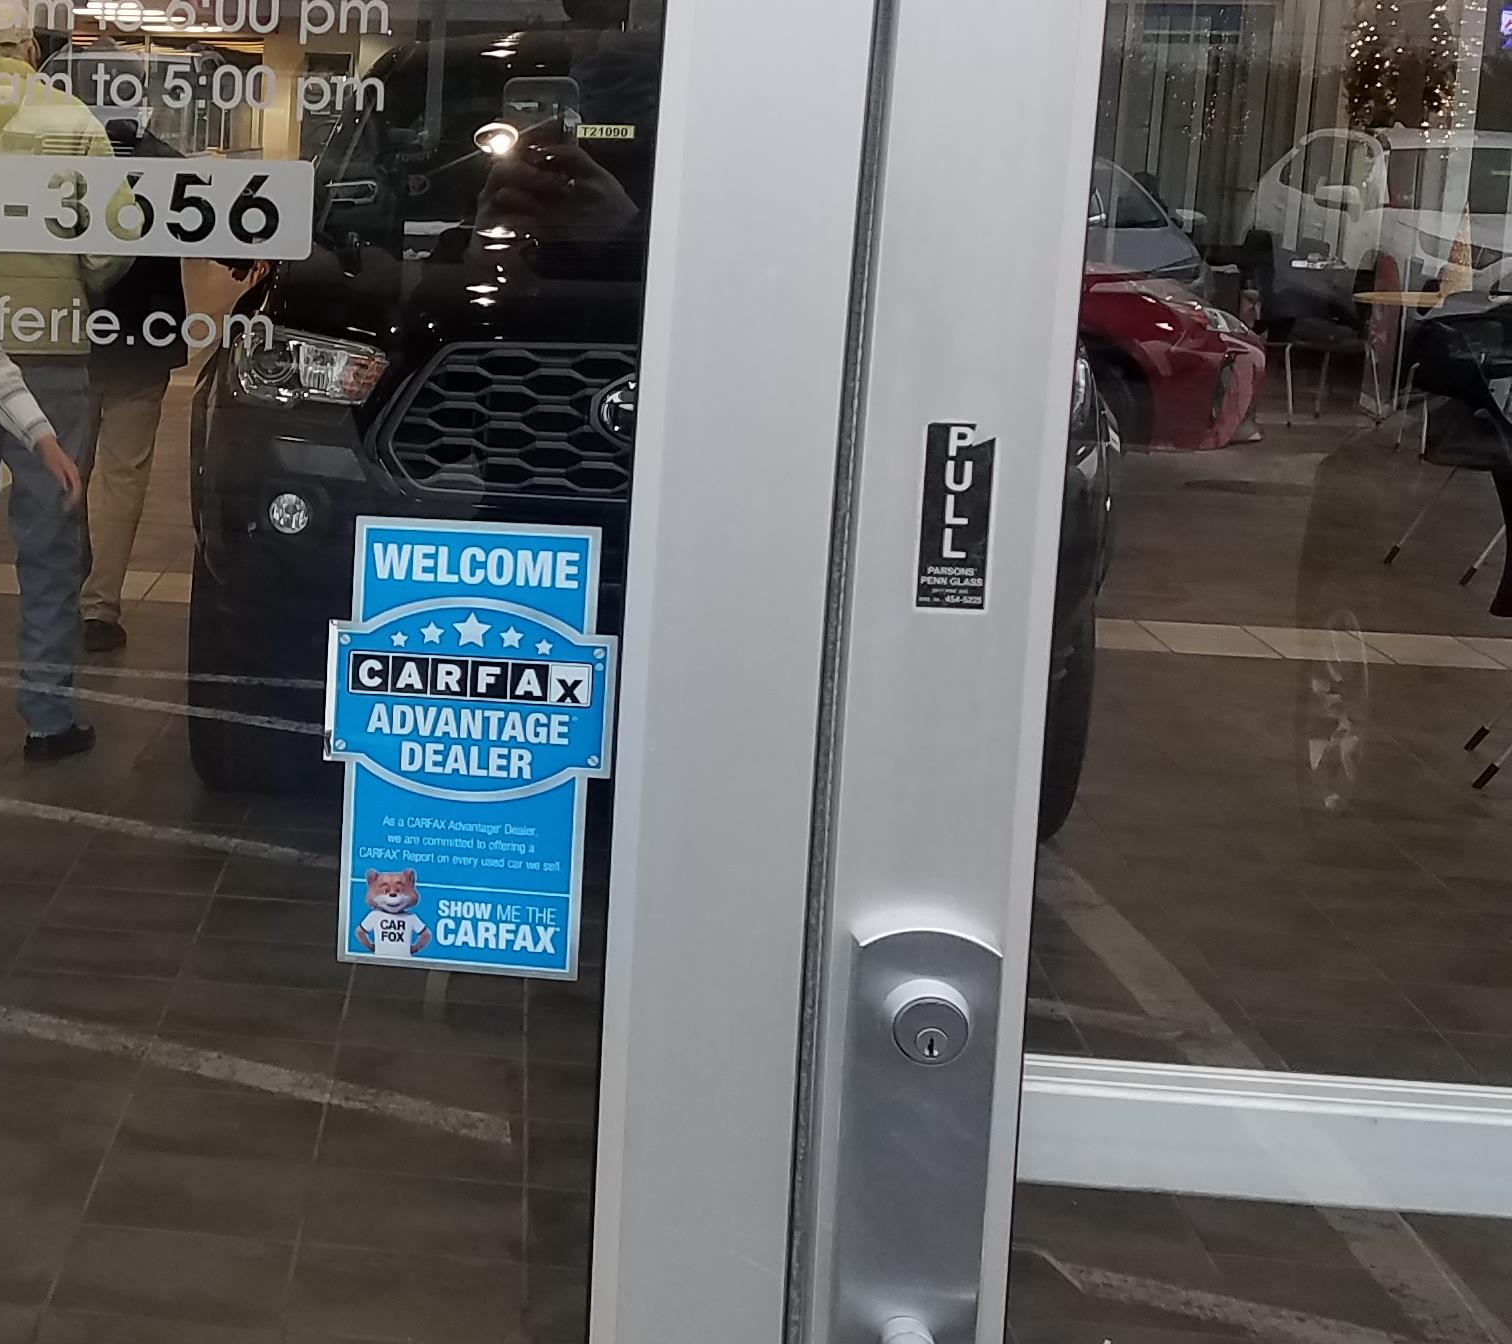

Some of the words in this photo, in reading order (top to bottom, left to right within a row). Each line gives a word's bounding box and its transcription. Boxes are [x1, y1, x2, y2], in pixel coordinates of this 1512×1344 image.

[92, 62, 144, 108] to
[161, 63, 274, 110] 5:00
[293, 68, 387, 115] pm
[581, 126, 628, 137] T21090
[942, 425, 975, 559] PULL
[373, 542, 581, 589] WELCOME
[358, 658, 584, 704] CARFAX
[366, 703, 570, 746] ADVANTAGE
[400, 740, 533, 780] DEALER
[407, 817, 446, 830] CARFAX
[402, 850, 435, 864] Report
[437, 854, 450, 864] on
[452, 855, 479, 869] every
[481, 856, 505, 868] used
[507, 859, 523, 869] car
[422, 836, 474, 850] committed
[476, 838, 486, 850] to
[488, 839, 526, 855] offering
[379, 919, 407, 931] CAR
[437, 899, 492, 919] SHOW
[496, 904, 522, 923] ME
[525, 906, 557, 926] THE
[380, 931, 405, 943] FOX
[436, 917, 556, 955] CARFAX
